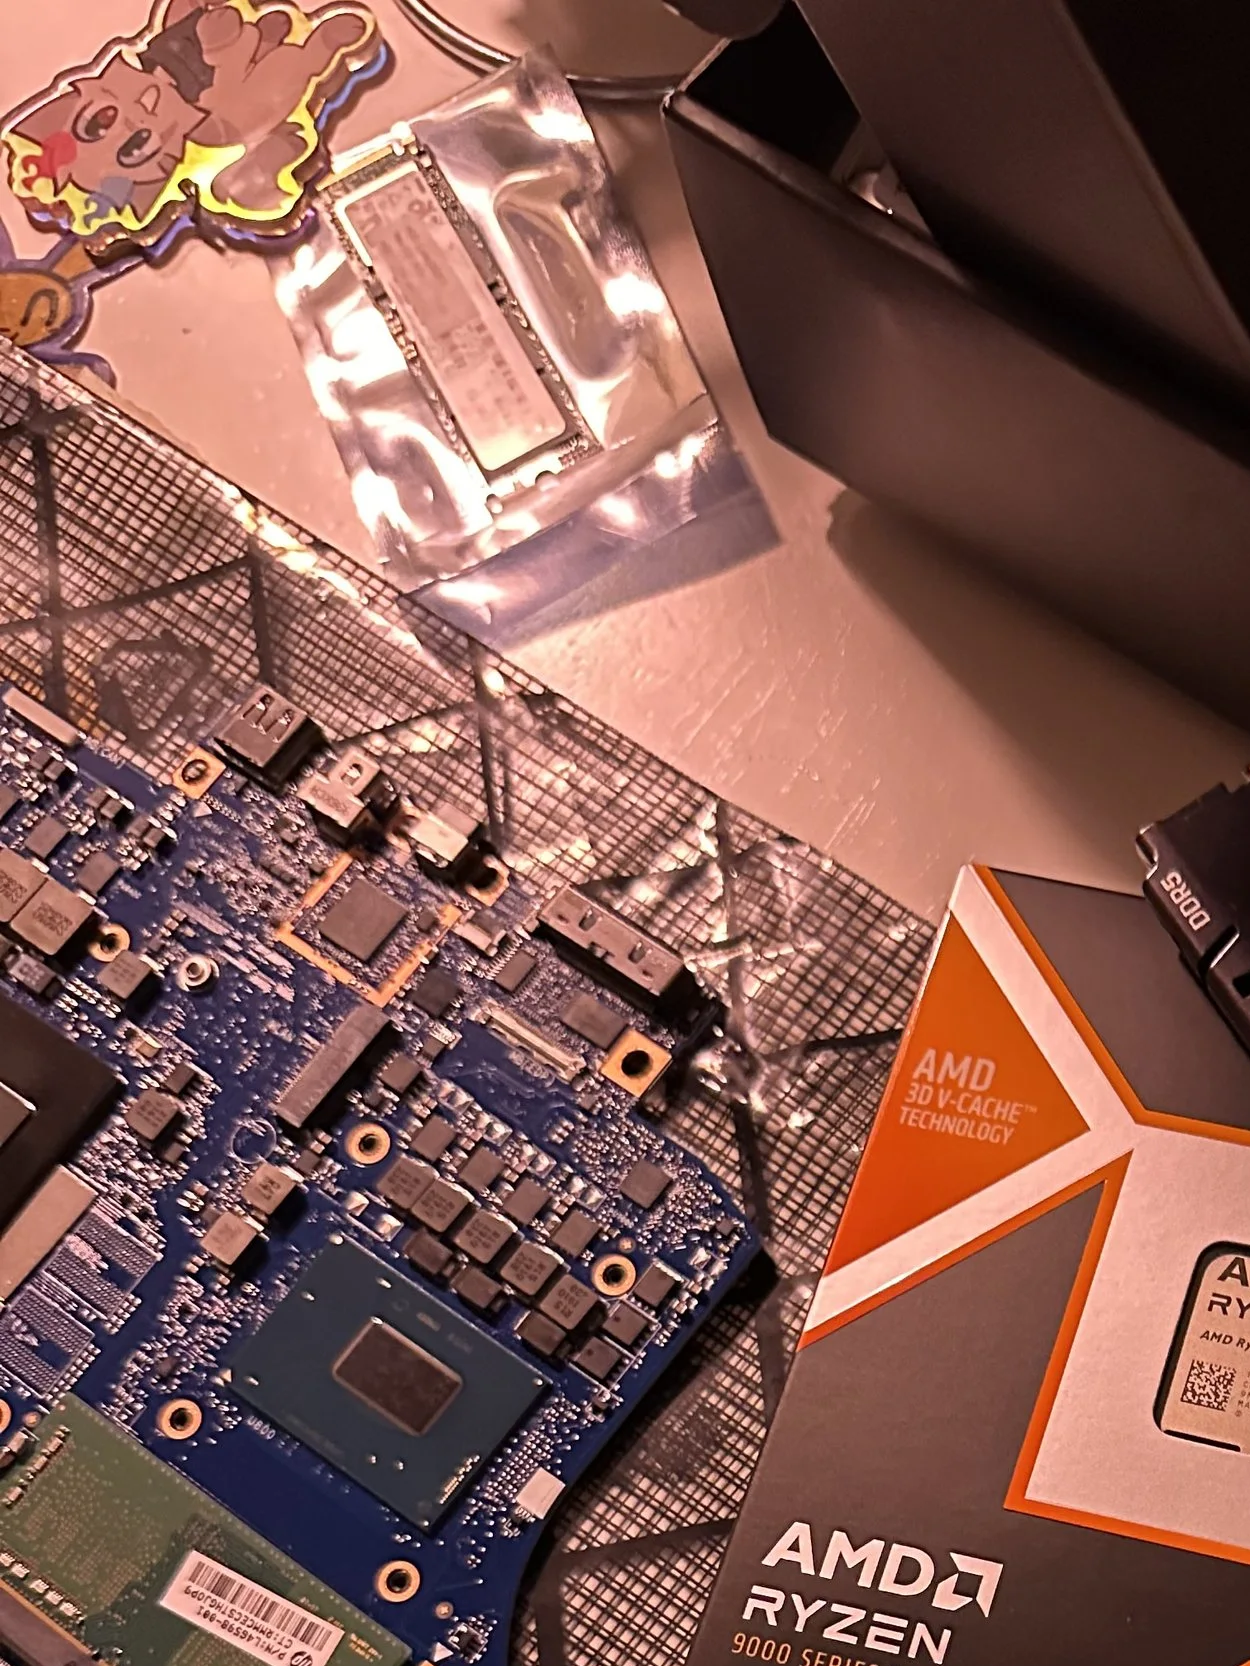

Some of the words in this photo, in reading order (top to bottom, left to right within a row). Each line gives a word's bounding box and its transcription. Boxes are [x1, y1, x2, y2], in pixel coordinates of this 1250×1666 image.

[1160, 870, 1210, 931] DDR5
[912, 1048, 996, 1092] AMD
[904, 1082, 934, 1107] 3D
[900, 1106, 1015, 1145] TECHNOLOGY
[1200, 1330, 1233, 1345] AMD
[761, 1521, 935, 1596] AMD
[742, 1585, 951, 1665] RYZEN
[731, 1632, 792, 1665] 9000
